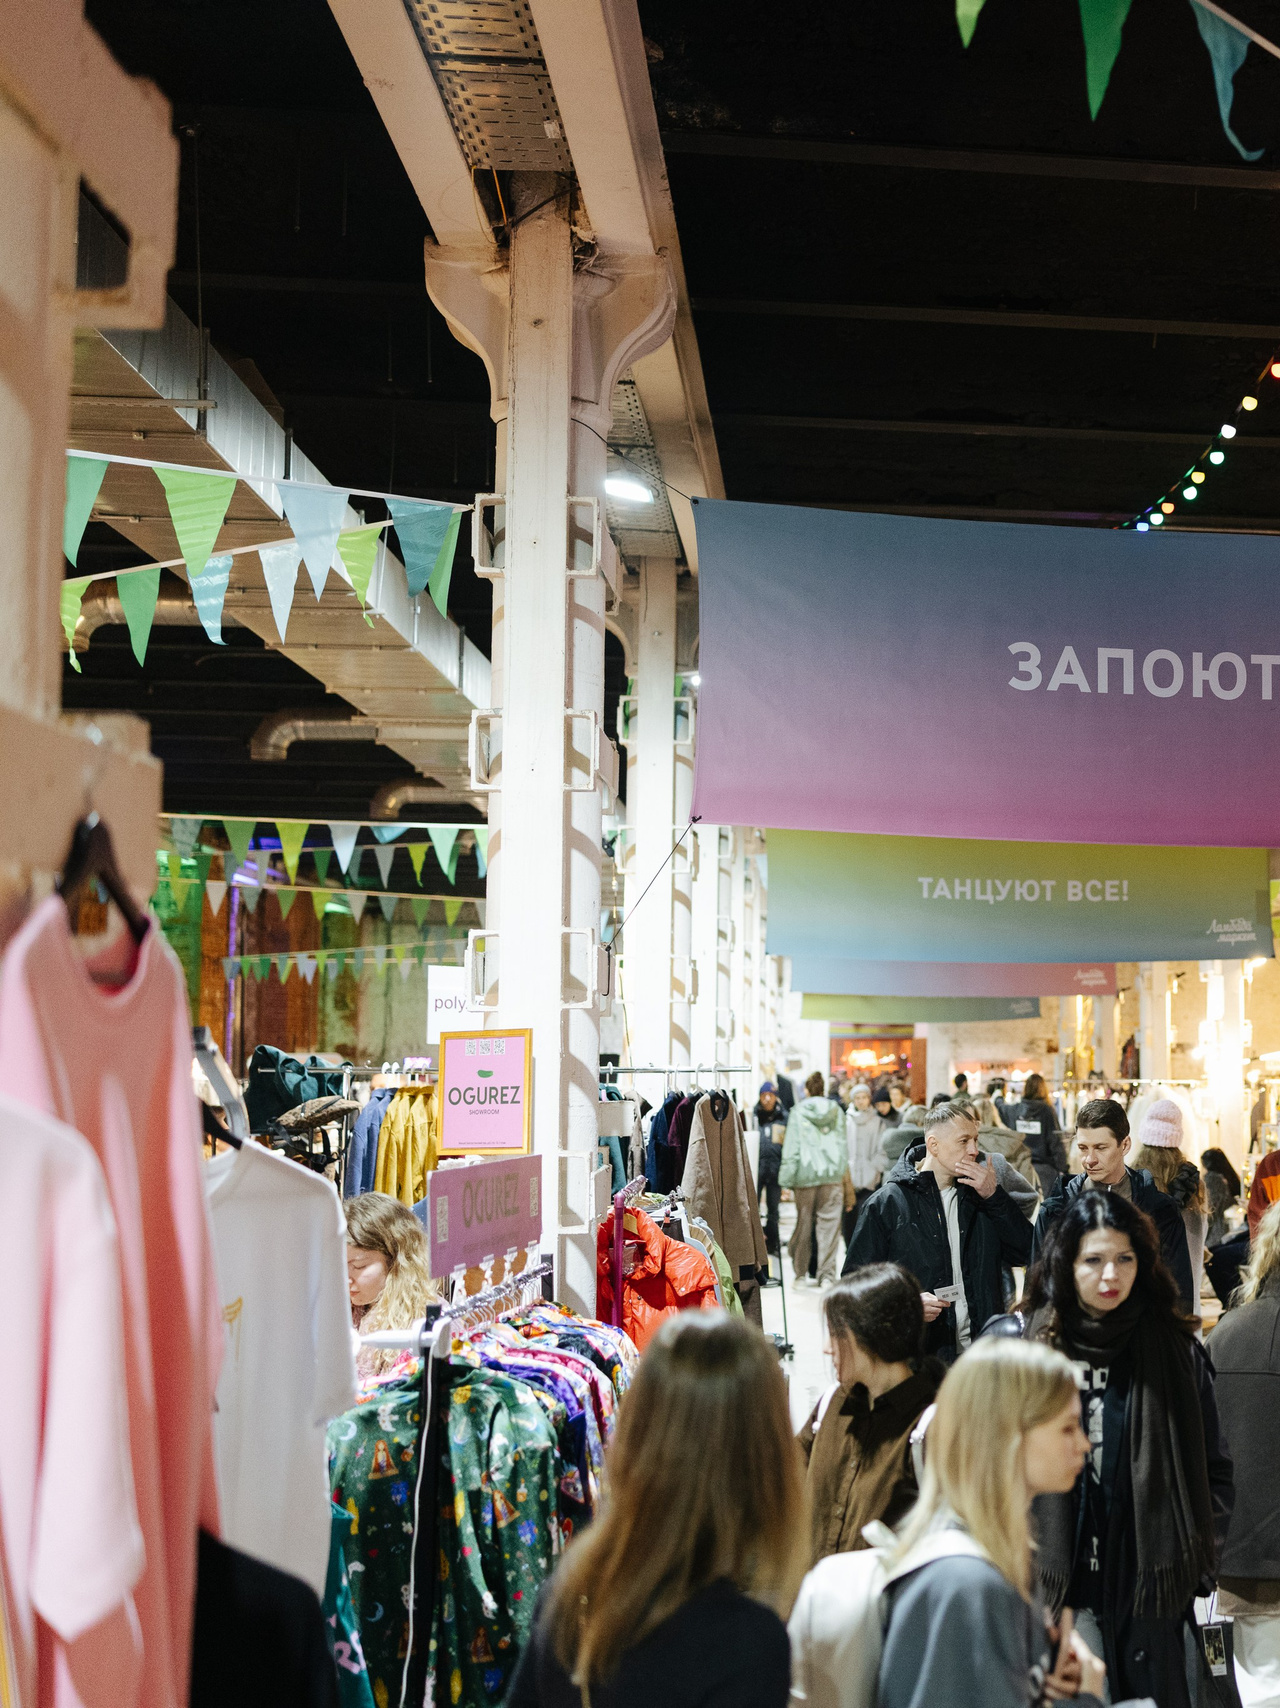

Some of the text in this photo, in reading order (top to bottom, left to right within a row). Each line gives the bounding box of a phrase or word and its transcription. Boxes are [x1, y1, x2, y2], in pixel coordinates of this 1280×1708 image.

[918, 877, 1129, 904] ТАНЦУЮТ ВСЕ!
[448, 1086, 521, 1105] OGUREZ
[462, 1172, 520, 1228] OGUREZ
